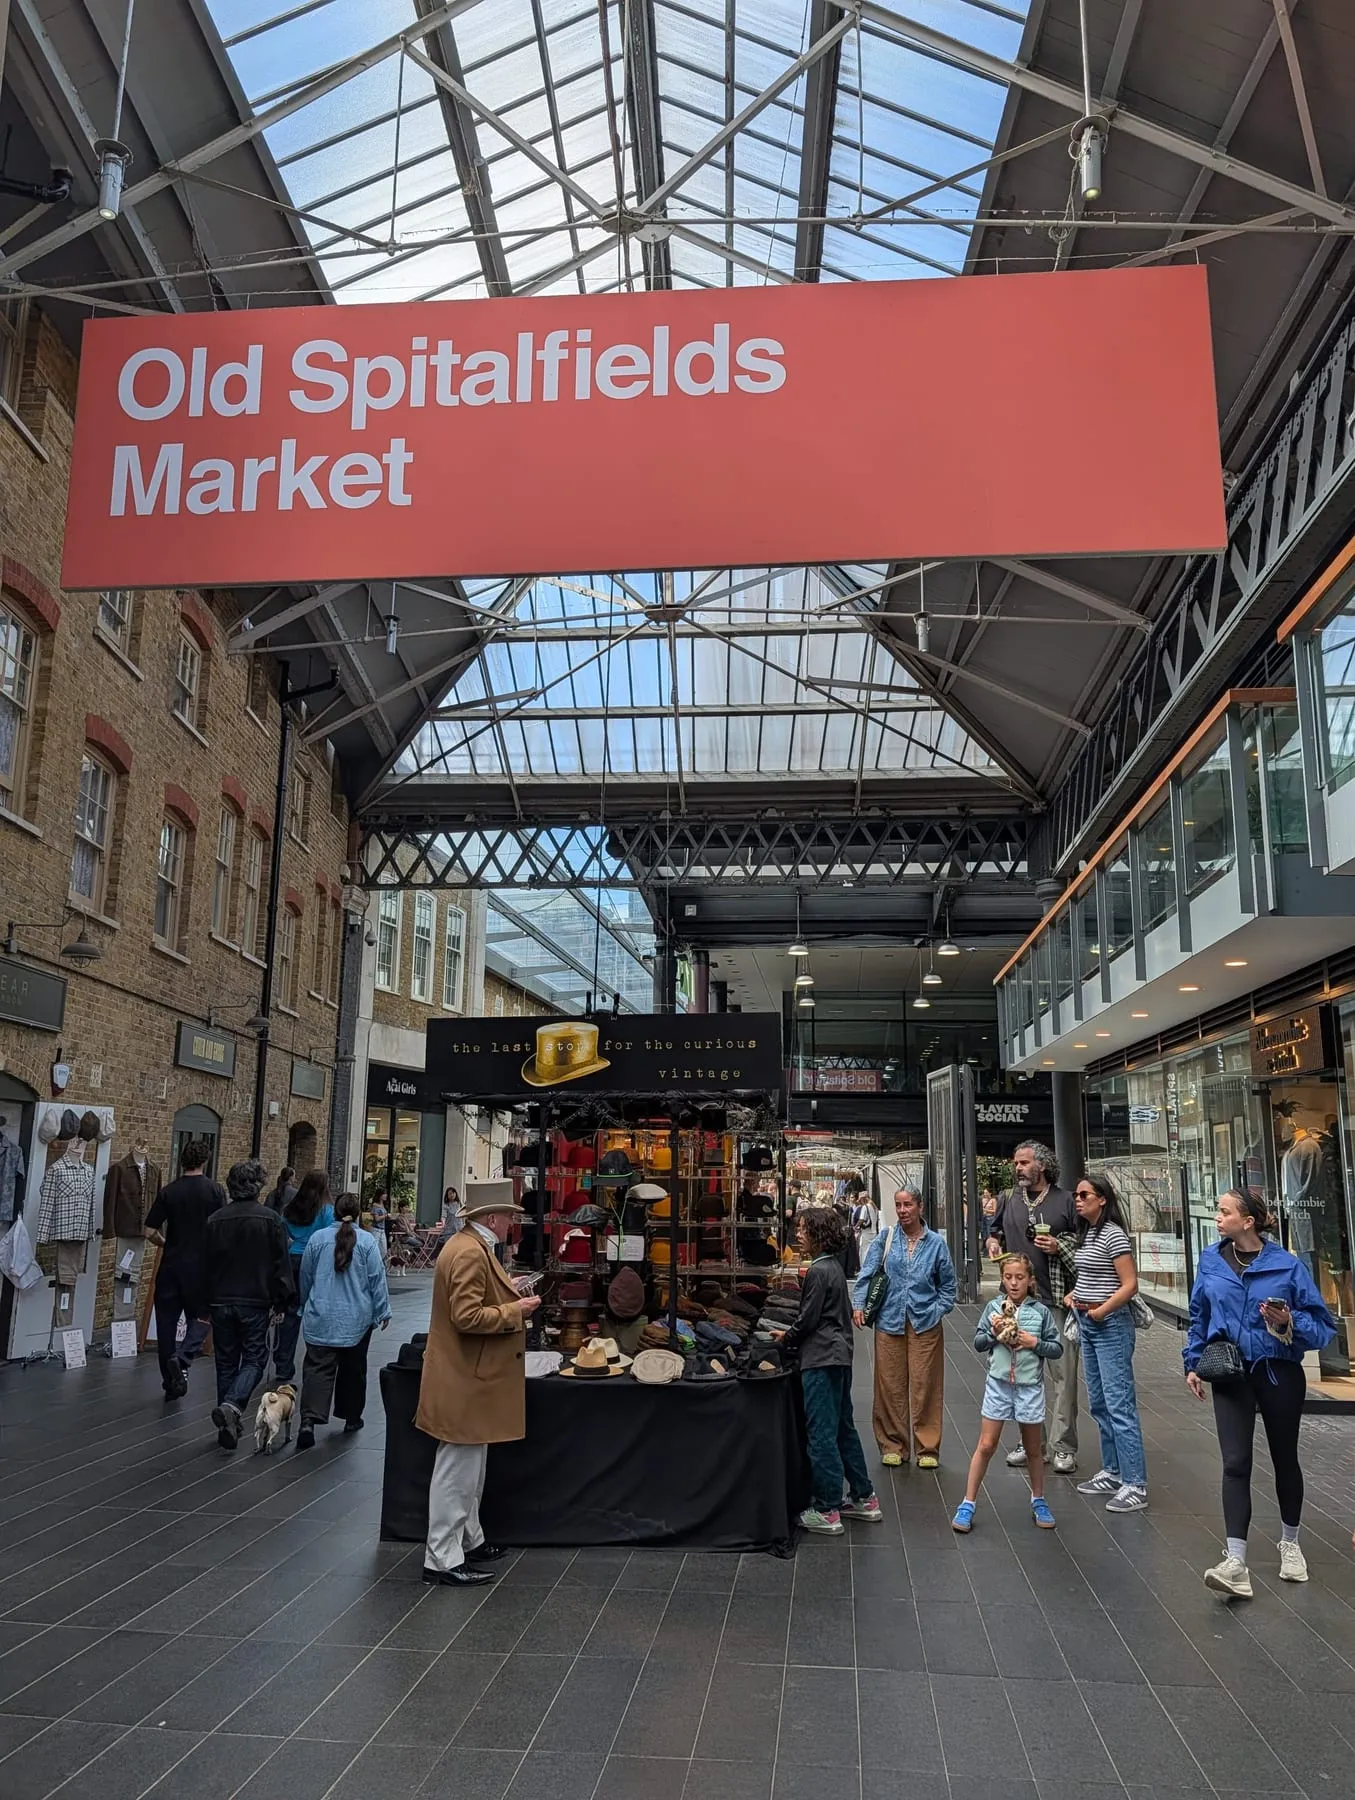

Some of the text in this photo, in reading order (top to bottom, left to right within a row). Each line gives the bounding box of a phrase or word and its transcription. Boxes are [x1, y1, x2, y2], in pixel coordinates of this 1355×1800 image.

[118, 323, 787, 430] Old Spitalfields
[110, 438, 413, 517] Market
[452, 1043, 481, 1053] the
[491, 1042, 531, 1053] last
[604, 1039, 633, 1051] for
[645, 1039, 673, 1050] the
[684, 1038, 757, 1049] curious
[659, 1067, 741, 1081] vintage
[977, 1113, 1024, 1122] SOCIAL
